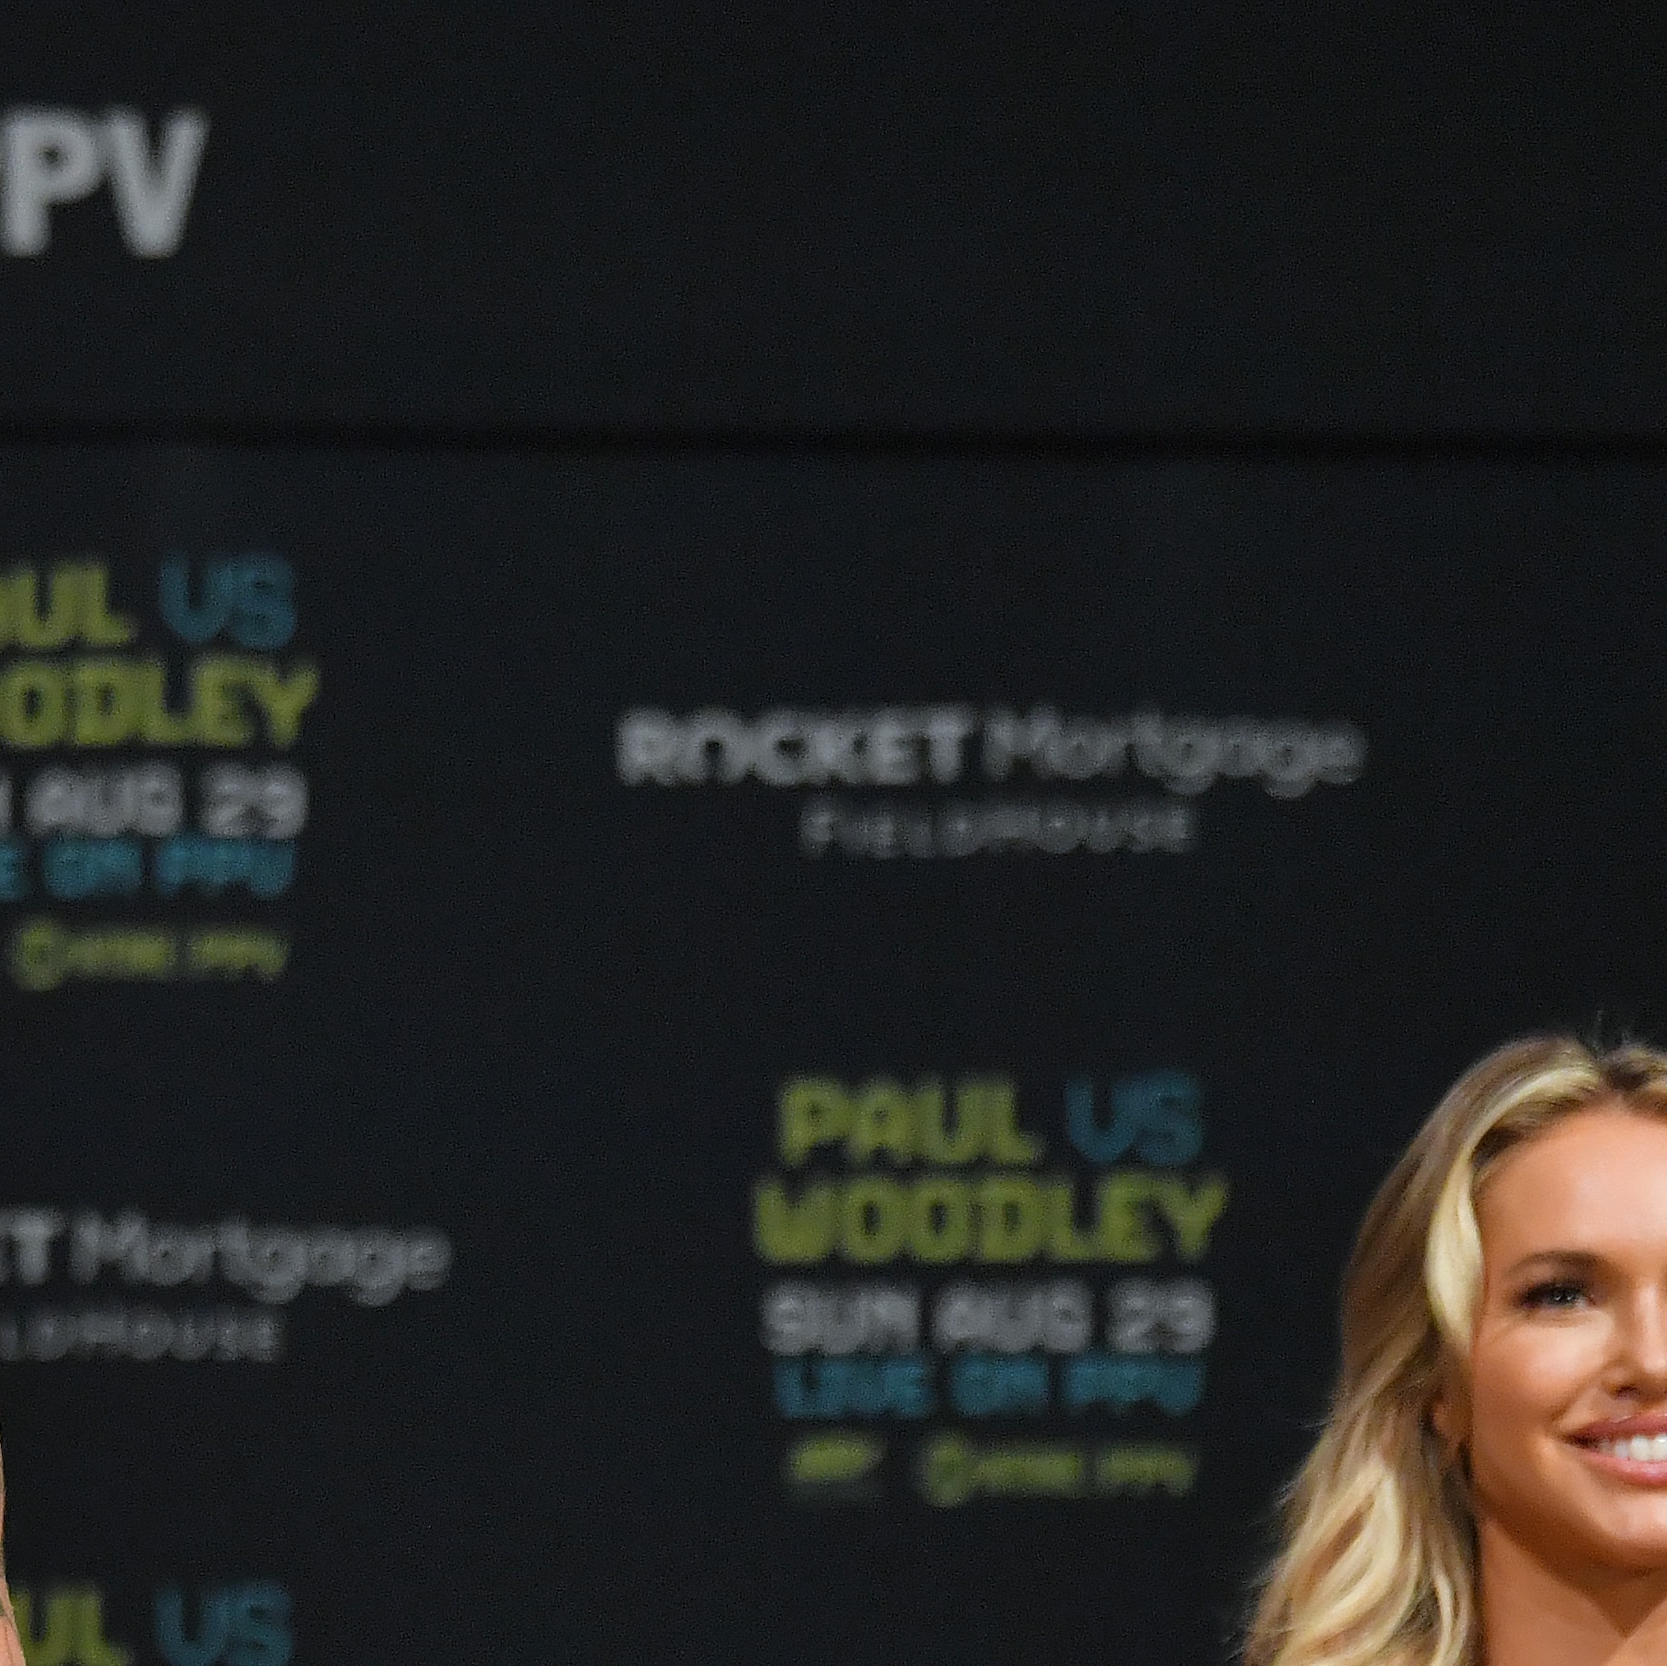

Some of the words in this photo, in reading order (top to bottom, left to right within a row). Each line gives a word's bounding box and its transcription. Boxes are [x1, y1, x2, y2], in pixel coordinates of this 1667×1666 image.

[616, 703, 978, 787] ROCKET
[980, 701, 1367, 799] Mortgage
[24, 760, 186, 839] AUG
[198, 760, 308, 841] 29
[778, 1072, 1048, 1169] PAUL
[69, 1206, 455, 1308] Mortgage
[752, 1167, 1229, 1266] WOODLEY
[761, 1276, 923, 1356] SUN
[930, 1274, 1093, 1355] AUG
[1105, 1276, 1216, 1355] 29
